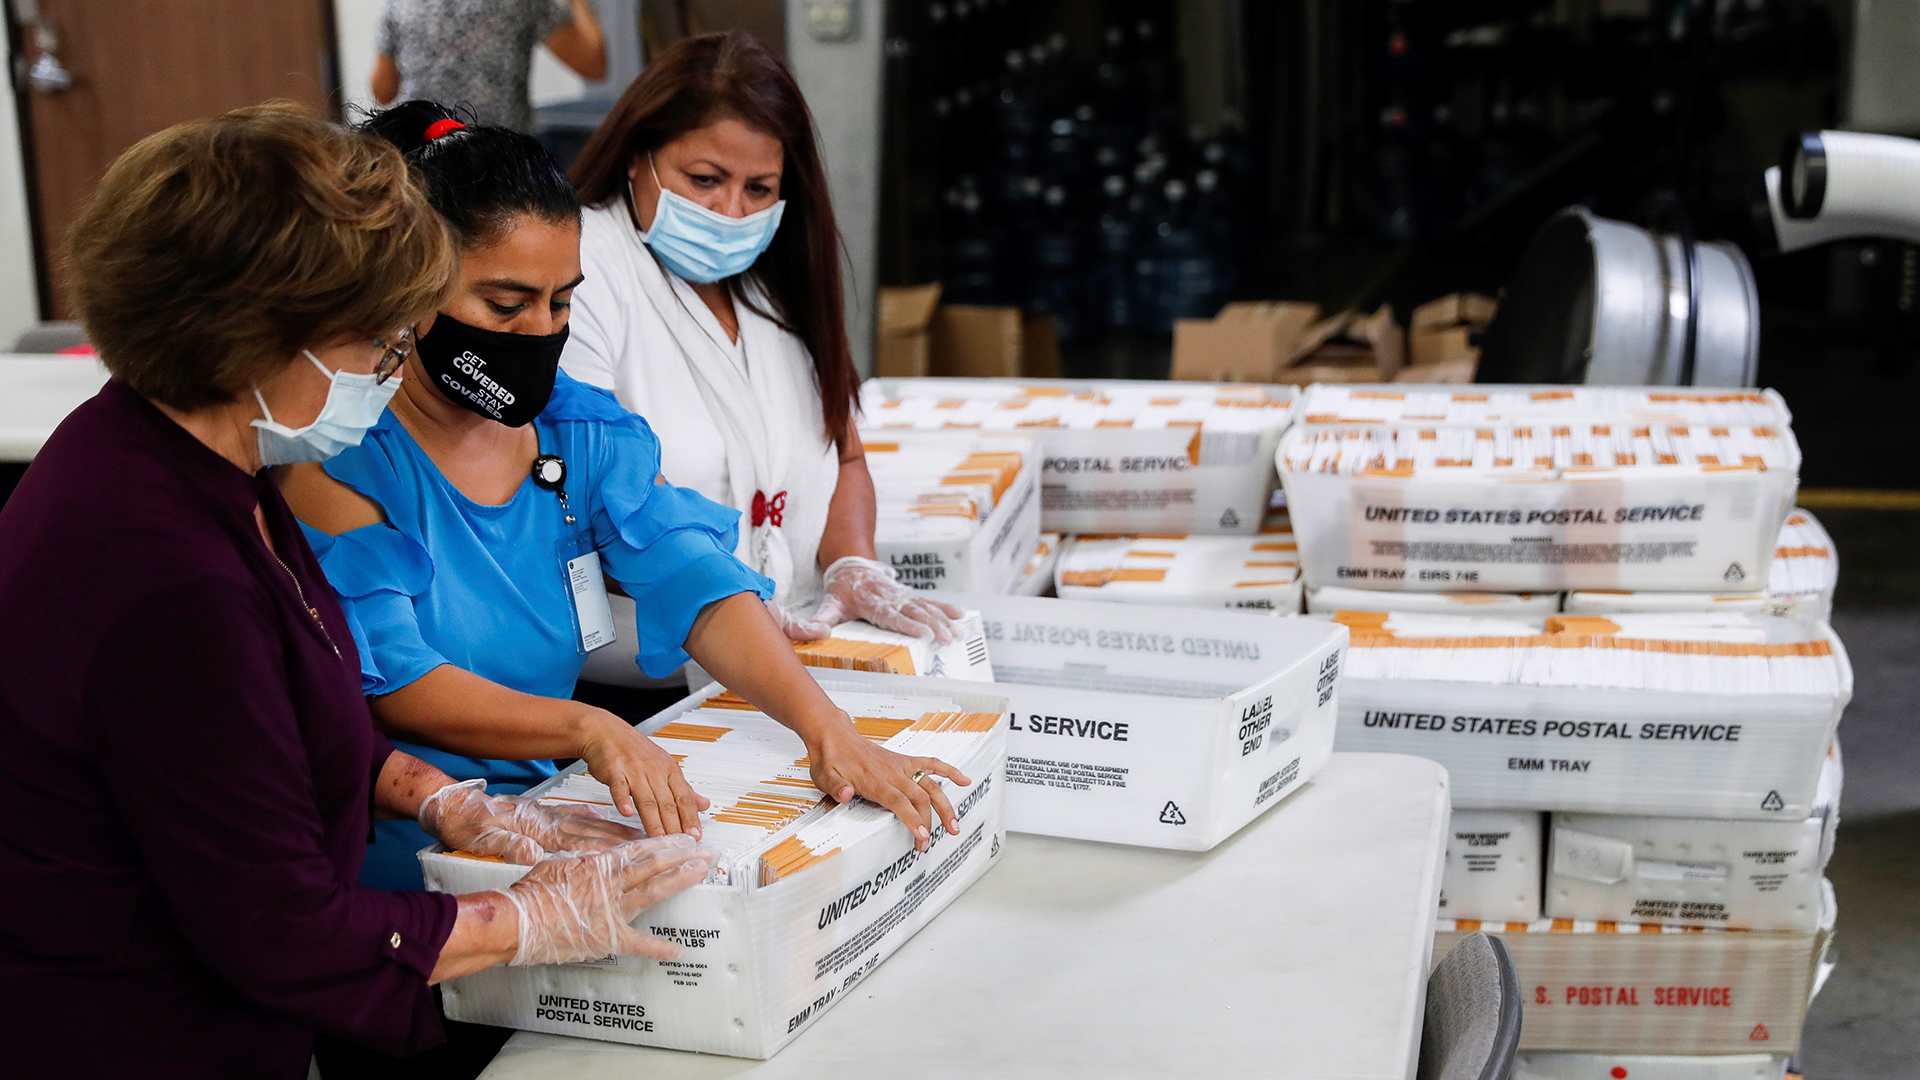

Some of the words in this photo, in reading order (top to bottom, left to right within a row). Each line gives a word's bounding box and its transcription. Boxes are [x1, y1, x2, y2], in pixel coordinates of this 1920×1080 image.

[462, 350, 487, 369] GET
[452, 356, 516, 405] COVERED
[441, 373, 503, 419] COVERED
[476, 388, 505, 411] STAY
[1042, 457, 1114, 474] POSTAL
[1118, 456, 1190, 473] SERVIC
[1365, 506, 1439, 524] UNITED
[1444, 508, 1521, 525] STATES
[1526, 508, 1607, 525] POSTAL
[1613, 503, 1705, 524] SERVICE
[890, 552, 944, 566] LABEL
[895, 566, 946, 581] OTHER
[1336, 566, 1369, 579] EMM
[1372, 567, 1406, 580] TRAY
[1418, 568, 1450, 581] EIRS
[1319, 648, 1341, 675] LABE
[1316, 665, 1339, 693] OTHER
[1317, 686, 1333, 708] END
[1029, 714, 1129, 742] SERVICE
[1239, 712, 1271, 741] OTHER
[1363, 711, 1446, 731] UNITED
[1451, 716, 1537, 736] STATES
[1542, 721, 1633, 739] POSTAL
[1639, 723, 1742, 742] SERVICE
[1242, 734, 1263, 757] END
[1007, 756, 1030, 764] POSTAL
[1094, 765, 1129, 774] EQUIPMENT
[1018, 764, 1045, 772] FEDERAL
[1097, 772, 1123, 781] SERVICE
[1259, 771, 1280, 793] UNITED
[1280, 756, 1300, 779] STATES
[1507, 757, 1544, 771] EMM
[1549, 759, 1591, 772] TRAY
[1023, 771, 1056, 780] VIOLATORS
[1070, 776, 1096, 785] SUBJECT
[1253, 785, 1275, 808] POSTAL
[1275, 767, 1299, 793] SERVICE
[818, 880, 872, 930] UNITED
[871, 847, 917, 895] STATES
[957, 772, 992, 818] SERVICE
[1631, 908, 1675, 918] POSTAL
[1679, 911, 1730, 920] SERVICE
[1635, 899, 1678, 909] UNITED
[1681, 901, 1724, 911] STATES
[650, 926, 677, 937] TARE
[679, 928, 720, 939] WEIGHT
[684, 938, 705, 948] LBS
[539, 994, 590, 1011] UNITED
[592, 1000, 645, 1018] STATES
[787, 1006, 811, 1034] EMM
[812, 986, 837, 1015] TRAY
[842, 966, 863, 993] EIRS
[1566, 986, 1639, 1006] POSTAL
[1653, 986, 1732, 1007] SERVICE
[536, 1008, 590, 1025] POSTAL
[593, 1014, 654, 1032] SERVICE
